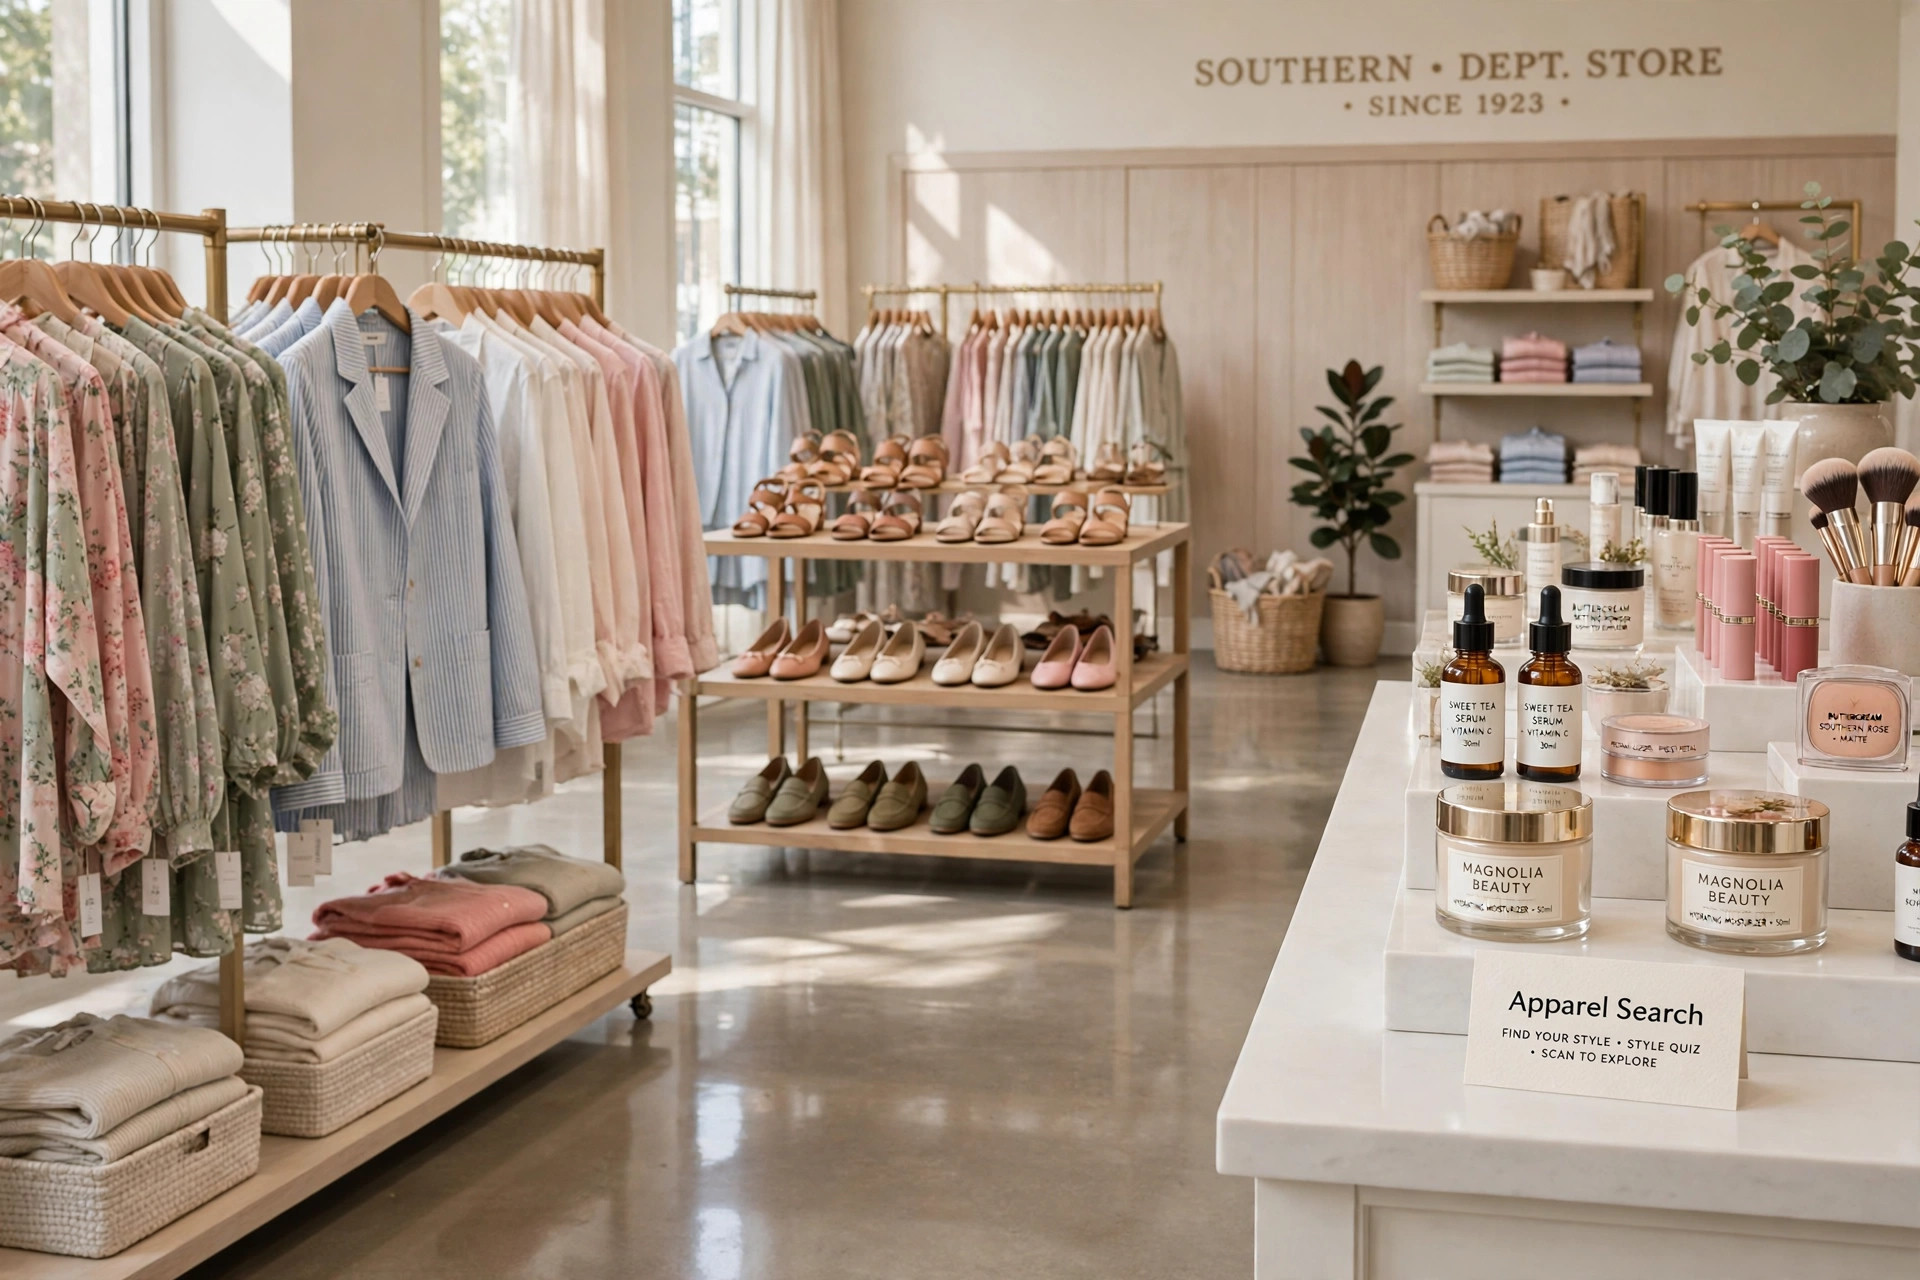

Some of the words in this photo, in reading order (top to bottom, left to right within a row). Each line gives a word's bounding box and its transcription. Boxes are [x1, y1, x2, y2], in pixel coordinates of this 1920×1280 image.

[1195, 54, 1413, 87] SOUTHERN
[1459, 51, 1569, 82] DEPT.
[1587, 46, 1723, 79] STORE
[1369, 94, 1462, 117] SINCE
[1477, 92, 1545, 114] 1923
[1449, 701, 1477, 711] SWEET
[1480, 702, 1496, 710] TEA
[1524, 703, 1554, 713] SWEET
[1557, 704, 1574, 713] TEA
[1455, 714, 1486, 723] SERUM
[1532, 716, 1563, 726] SERUM
[1867, 725, 1889, 733] ROSE
[1463, 862, 1544, 879] MAGNOLIA
[1472, 879, 1531, 894] BEAUTY
[1698, 873, 1784, 890] MAGNOLIA
[1708, 890, 1771, 906] BEAUTY
[1508, 990, 1608, 1019] Apparel
[1616, 997, 1704, 1026] Search
[1502, 1027, 1530, 1040] FIND
[1535, 1031, 1569, 1043] YOUR
[1573, 1034, 1611, 1047] STYLE
[1627, 1039, 1665, 1052] STYLE
[1669, 1043, 1701, 1055] QUIZ
[1541, 1048, 1575, 1061] SCAN
[1580, 1051, 1597, 1062] TO
[1601, 1053, 1658, 1068] EXPLORE
